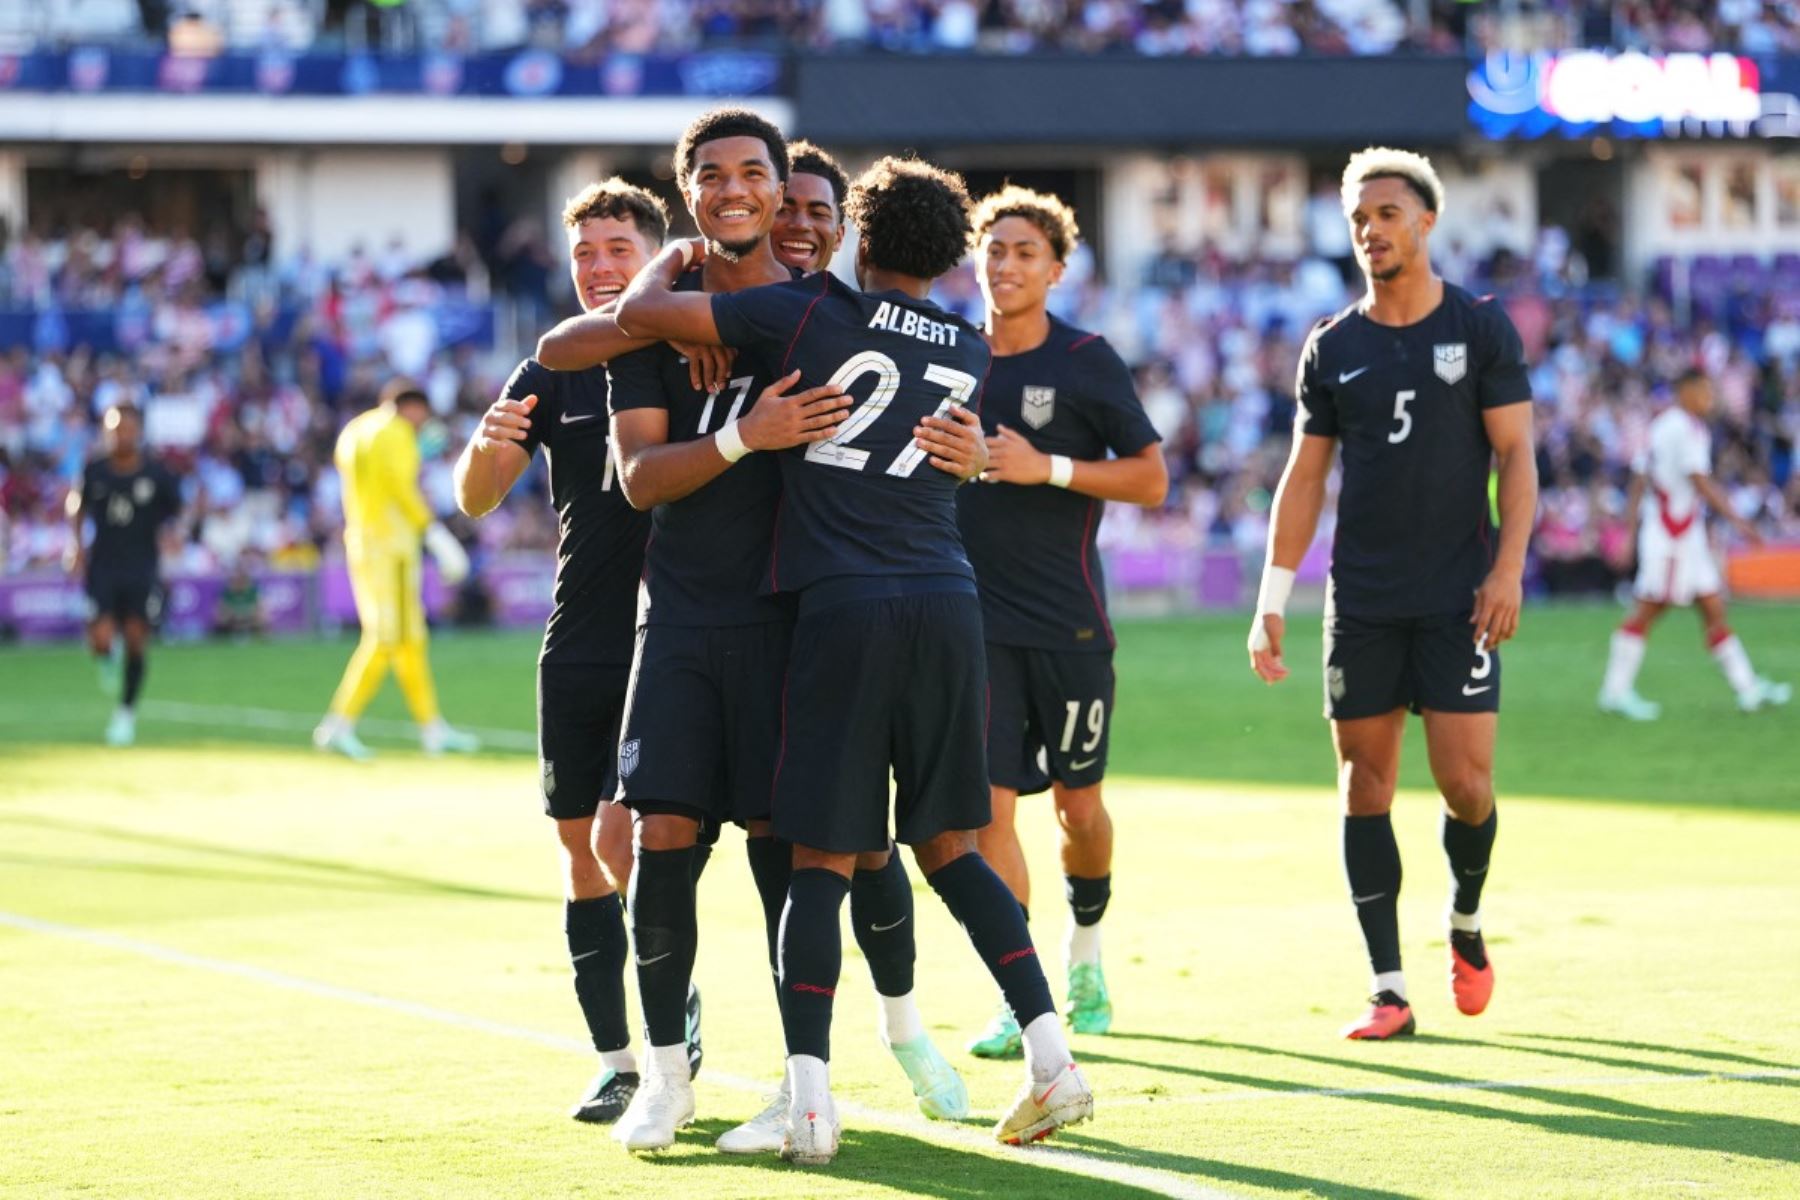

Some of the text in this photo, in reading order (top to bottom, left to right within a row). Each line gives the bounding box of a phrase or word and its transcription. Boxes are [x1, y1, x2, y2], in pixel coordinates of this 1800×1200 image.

[1549, 52, 1760, 122] GOAL
[868, 301, 960, 347] ALBERT
[804, 350, 978, 479] 27
[1387, 389, 1416, 444] 5
[1059, 698, 1105, 752] 19
